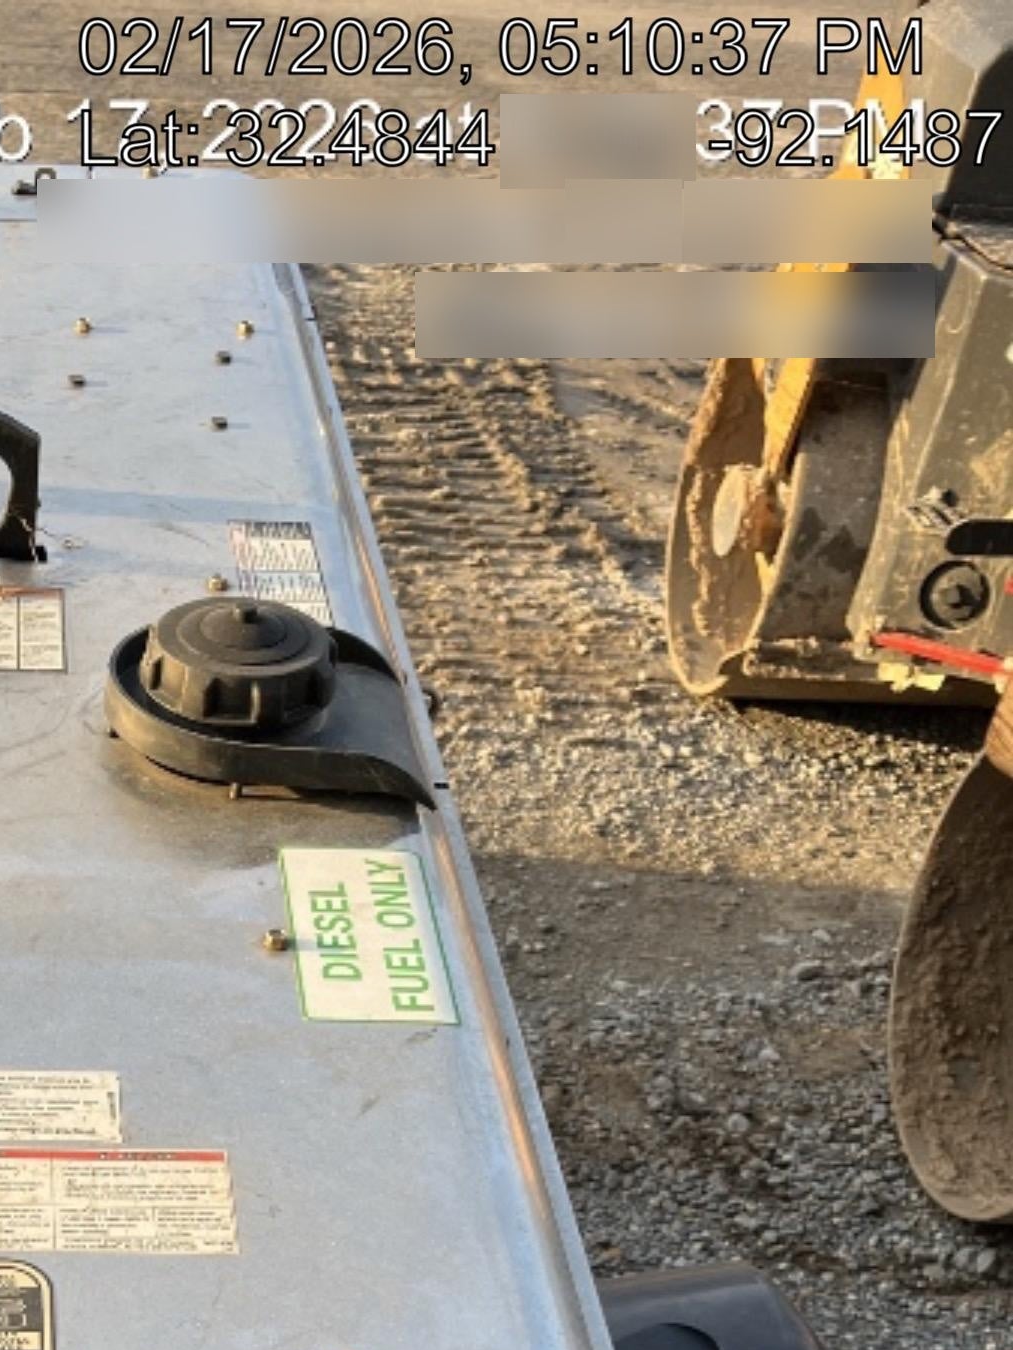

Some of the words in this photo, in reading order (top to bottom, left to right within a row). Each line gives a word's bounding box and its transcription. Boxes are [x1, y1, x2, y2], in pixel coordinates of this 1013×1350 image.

[364, 858, 415, 930] ONLY
[307, 881, 363, 982] DIESEL
[382, 938, 434, 1012] FUEL
